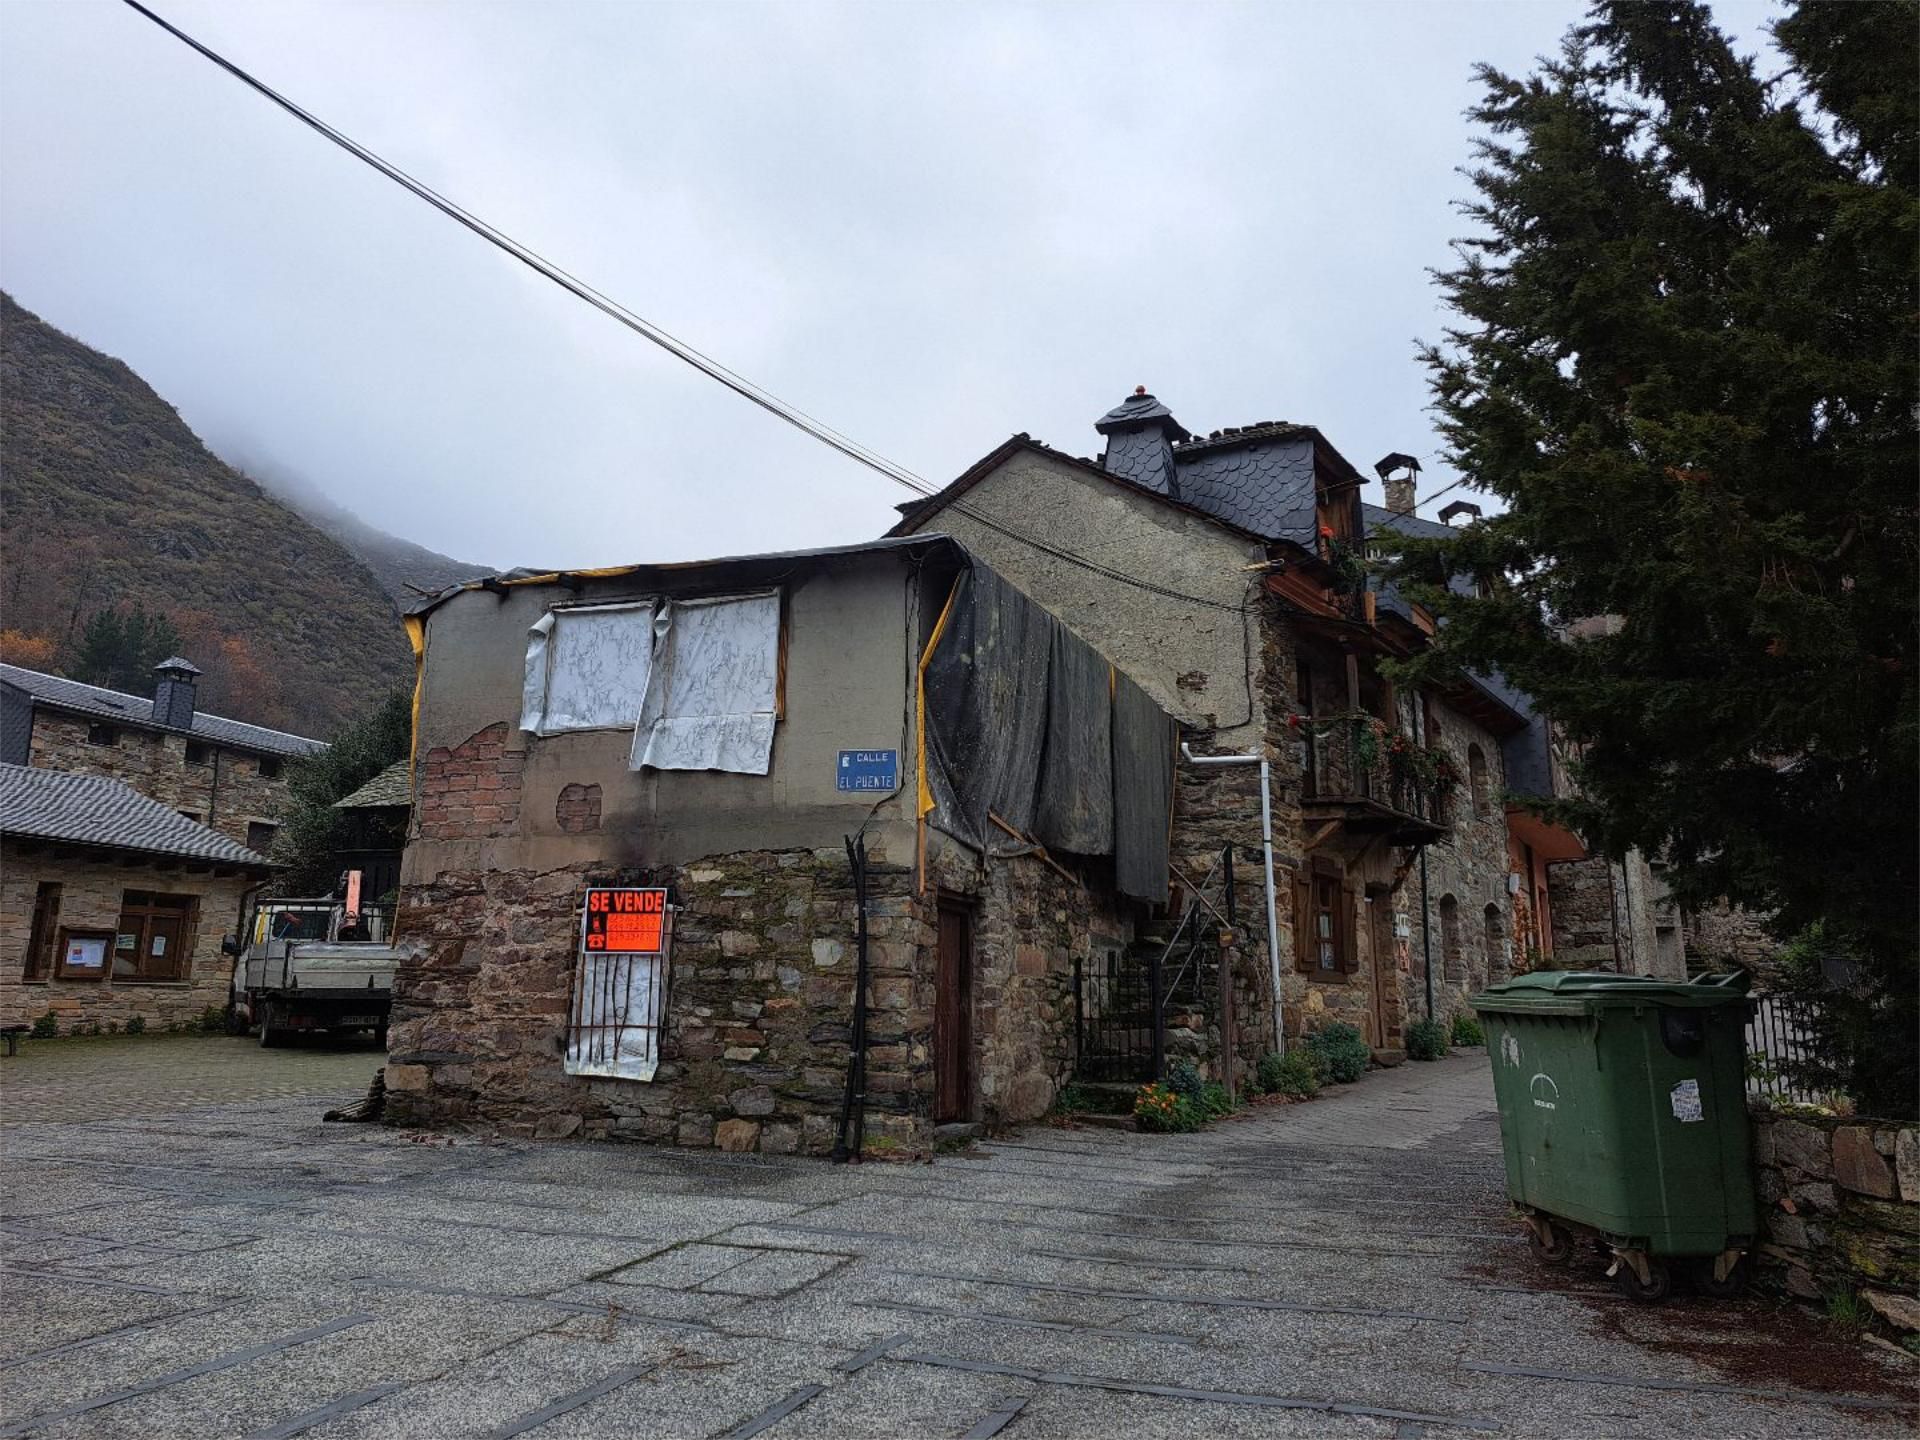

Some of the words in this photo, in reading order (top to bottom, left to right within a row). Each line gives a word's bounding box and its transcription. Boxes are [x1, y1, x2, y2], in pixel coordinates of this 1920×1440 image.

[856, 752, 889, 762] CALLE
[839, 776, 851, 789] EL
[855, 775, 893, 788] PUENTE
[590, 892, 610, 912] SE
[614, 892, 663, 912] VENDE
